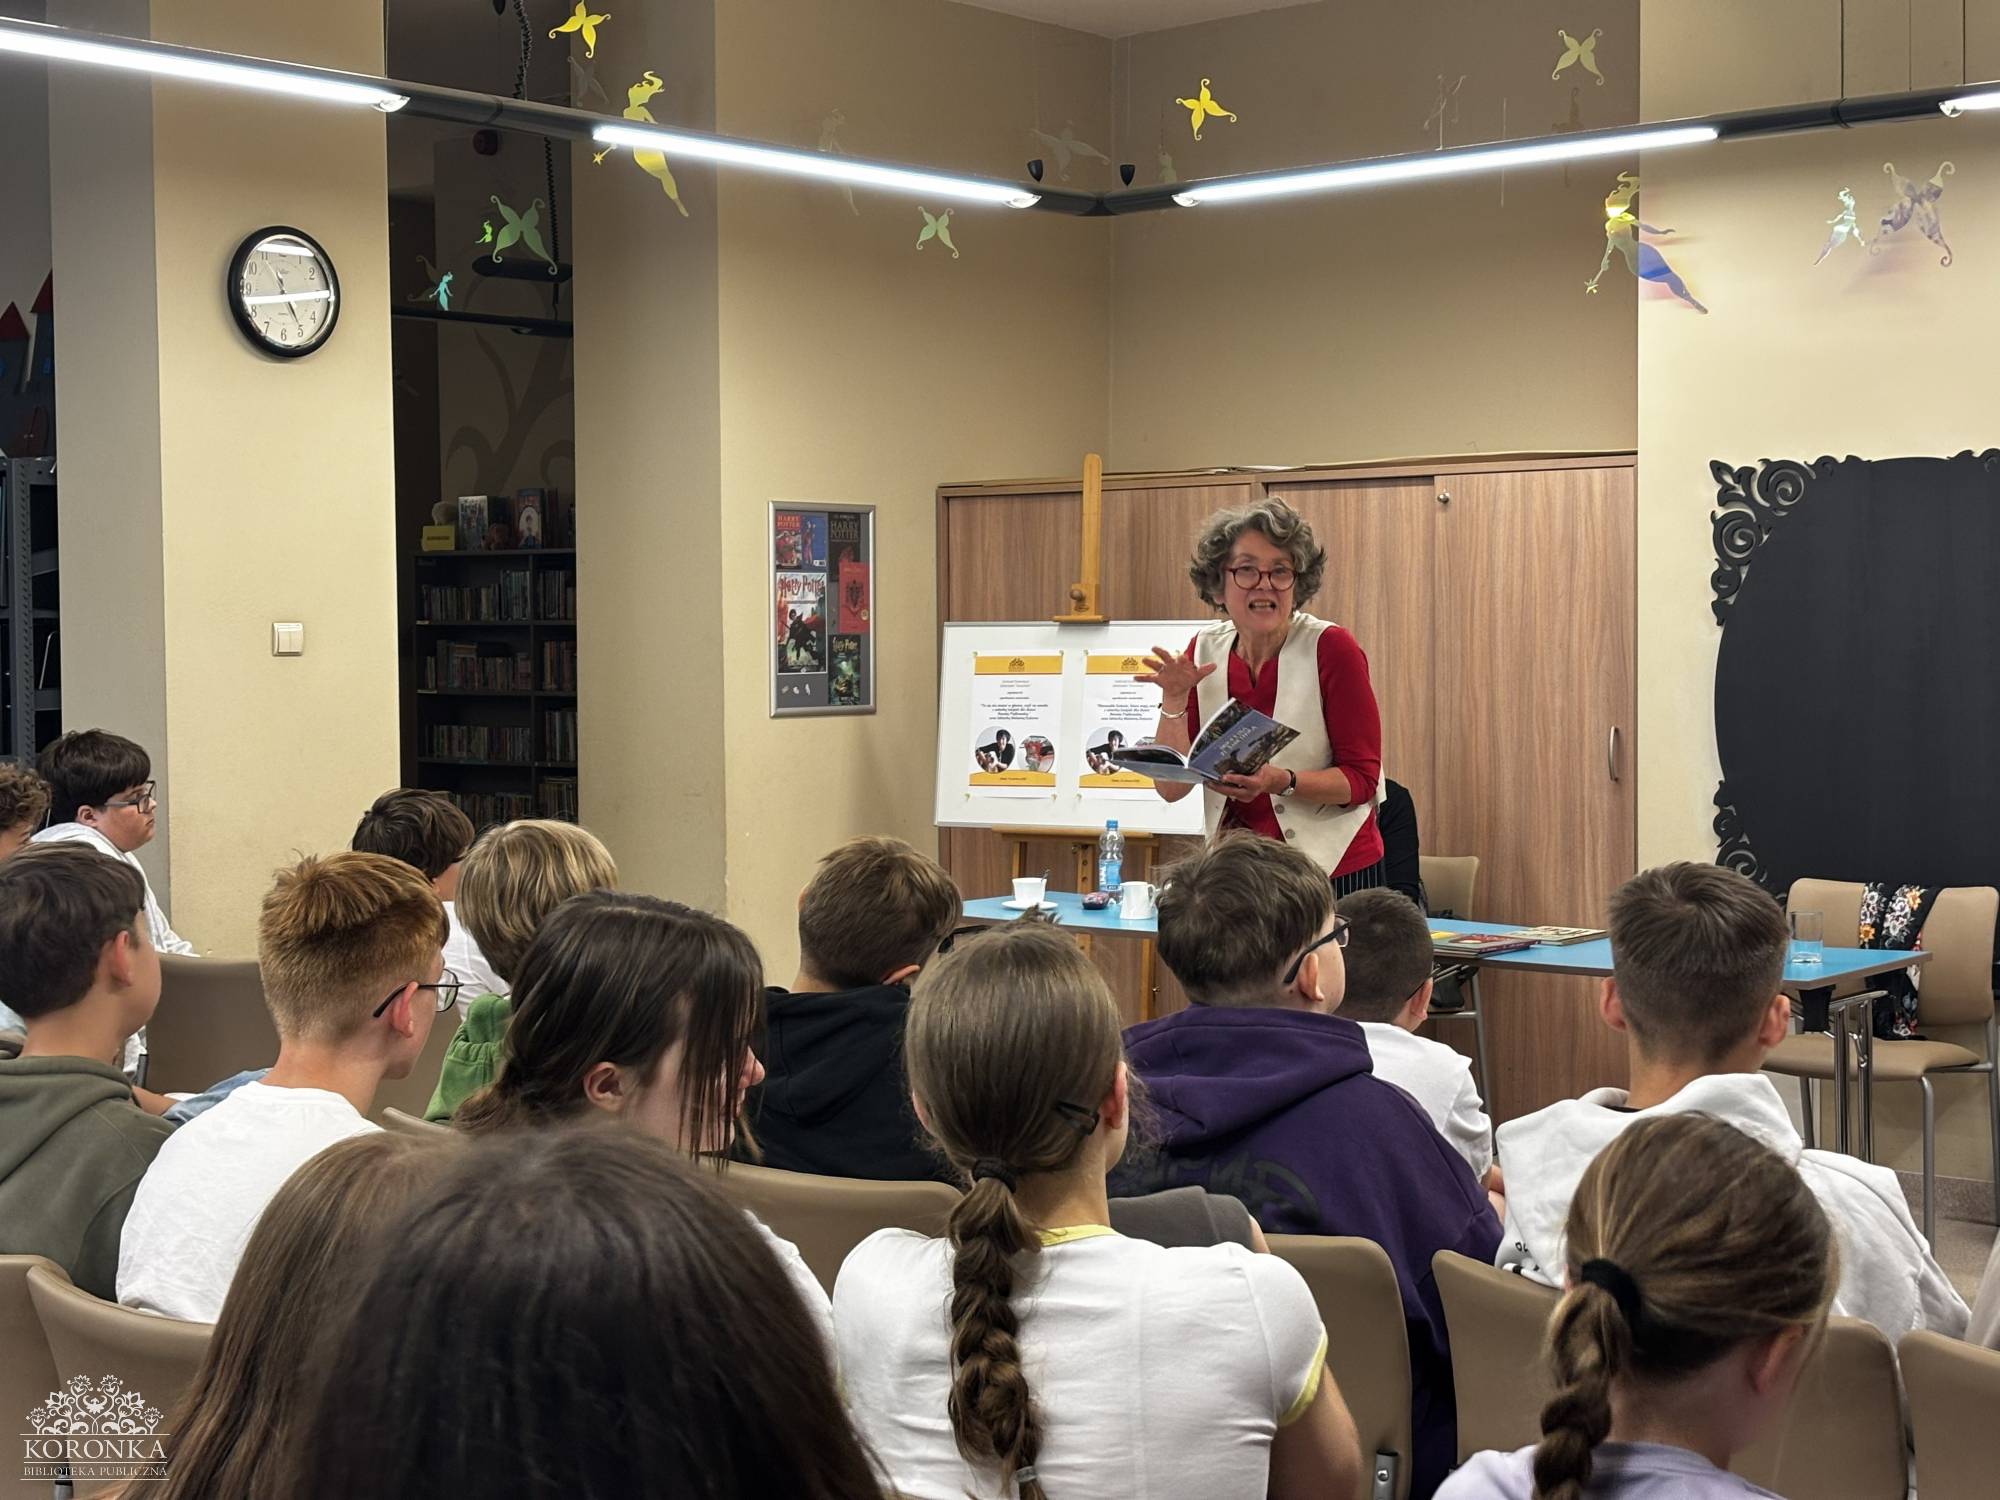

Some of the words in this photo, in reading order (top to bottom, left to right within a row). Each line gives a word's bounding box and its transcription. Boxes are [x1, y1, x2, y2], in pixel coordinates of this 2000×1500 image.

[248, 262, 257, 275] 10
[309, 267, 315, 280] 2
[246, 283, 252, 295] 9
[310, 311, 316, 324] 4
[264, 321, 270, 335] 7
[281, 328, 287, 341] 6
[297, 325, 304, 338] 5
[831, 520, 858, 530] HARRY
[831, 529, 859, 540] POTTER
